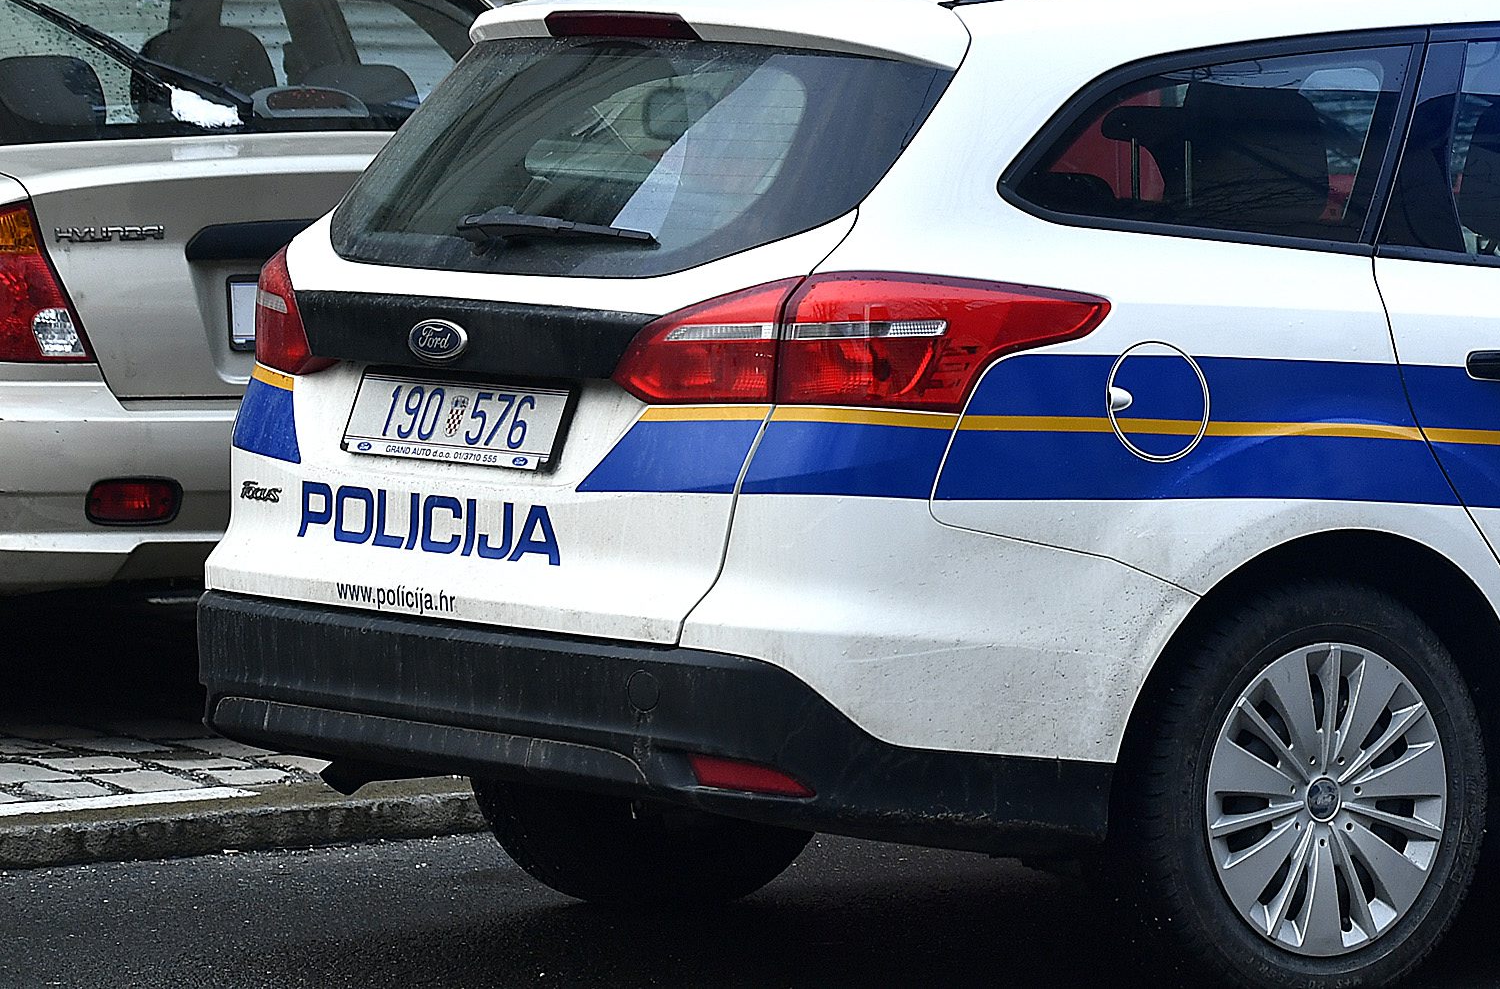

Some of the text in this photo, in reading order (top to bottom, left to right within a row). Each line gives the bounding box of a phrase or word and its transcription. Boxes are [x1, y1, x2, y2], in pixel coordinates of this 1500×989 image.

[54, 224, 165, 243] HYUNDAI
[418, 325, 450, 349] Ford
[382, 385, 536, 450] 190 576
[385, 444, 498, 463] GRAND AUTO d.o.o. 01/3710 555
[240, 480, 283, 503] Focus
[297, 480, 561, 567] POLICIJA
[336, 581, 456, 615] www.policija.hr
